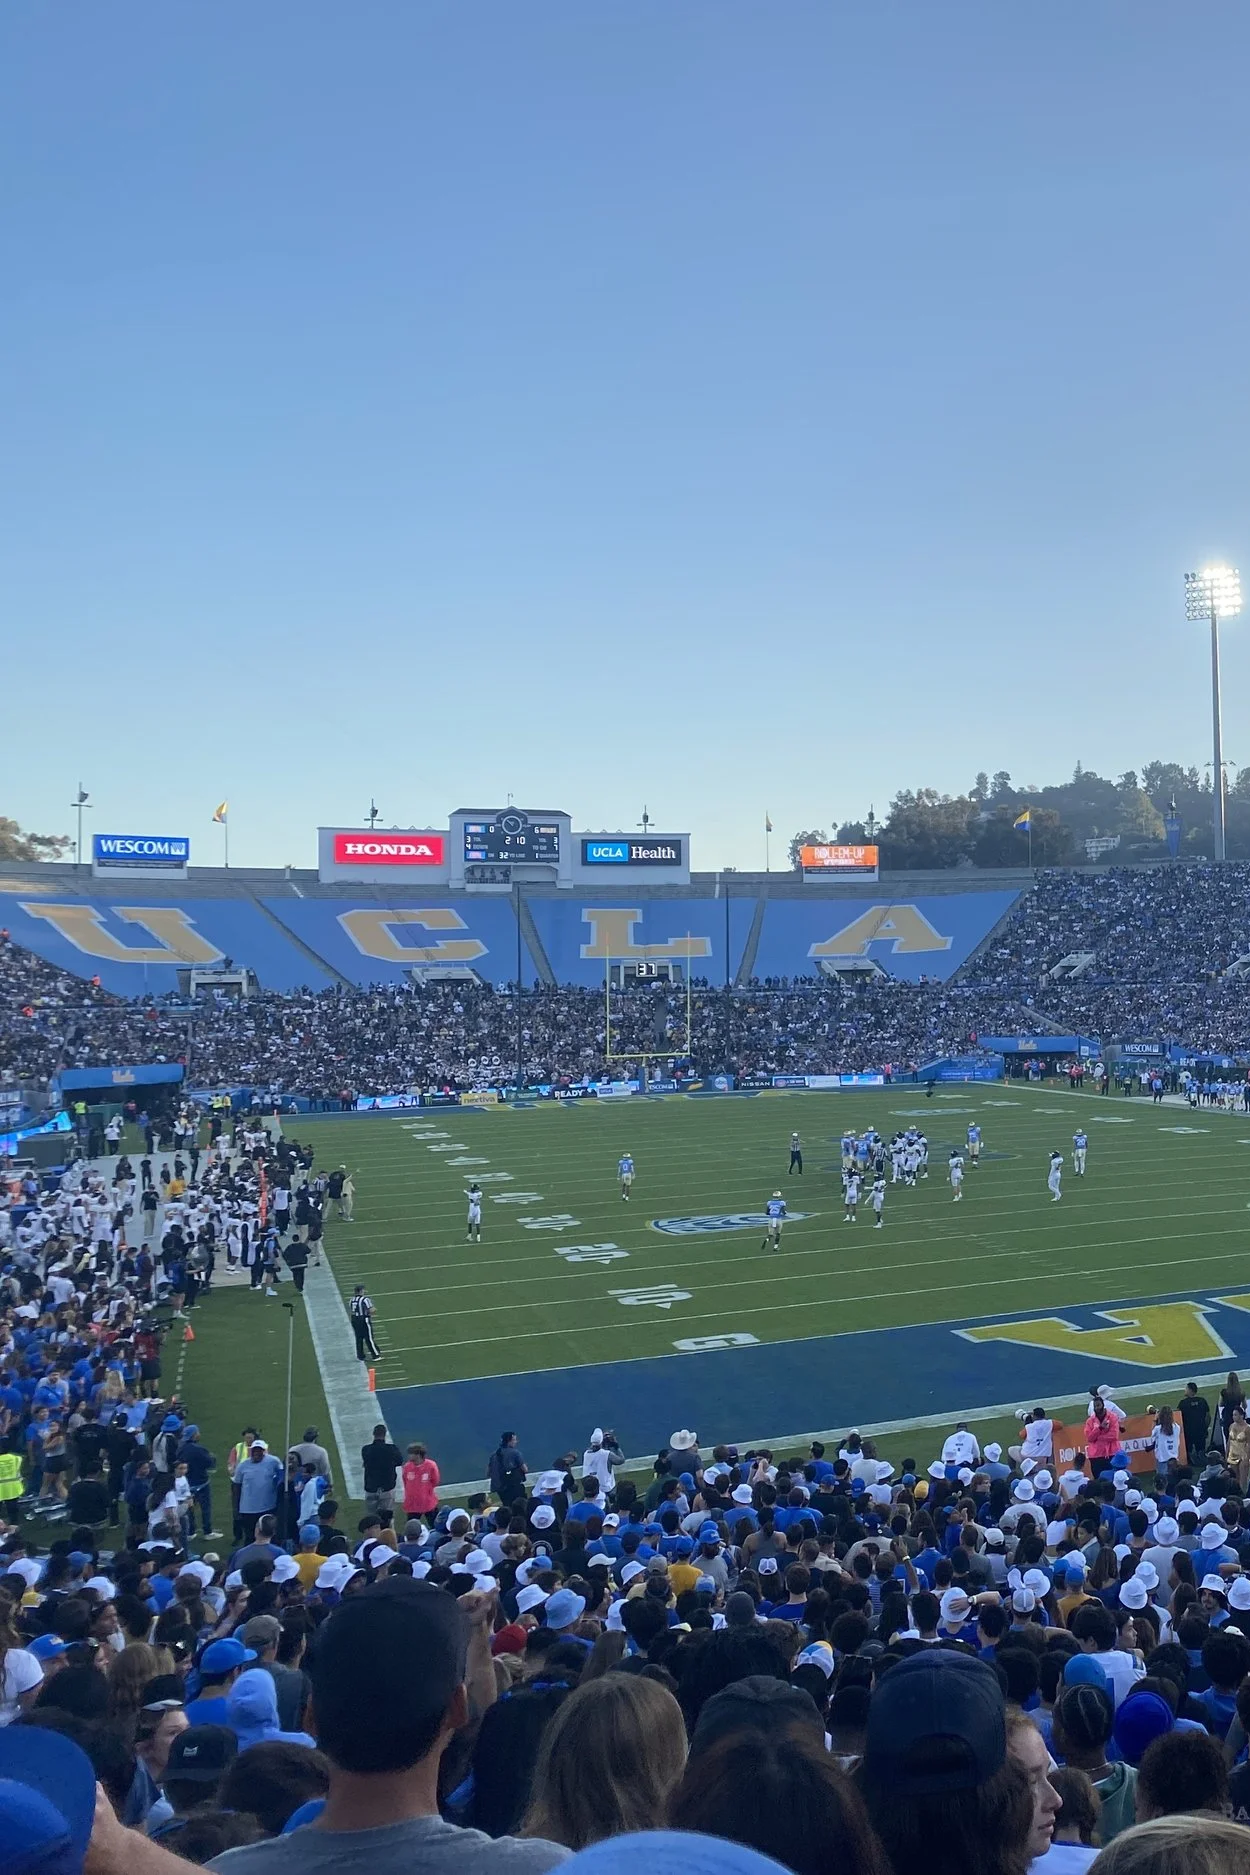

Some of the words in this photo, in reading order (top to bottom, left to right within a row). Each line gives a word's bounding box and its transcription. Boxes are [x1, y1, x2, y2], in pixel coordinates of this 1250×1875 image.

[100, 839, 169, 855] WESCOM
[344, 843, 434, 857] HONDA
[592, 847, 624, 858] UCLA
[631, 846, 676, 859] Health
[1124, 1044, 1152, 1053] WESCOM
[672, 1333, 759, 1351] G
